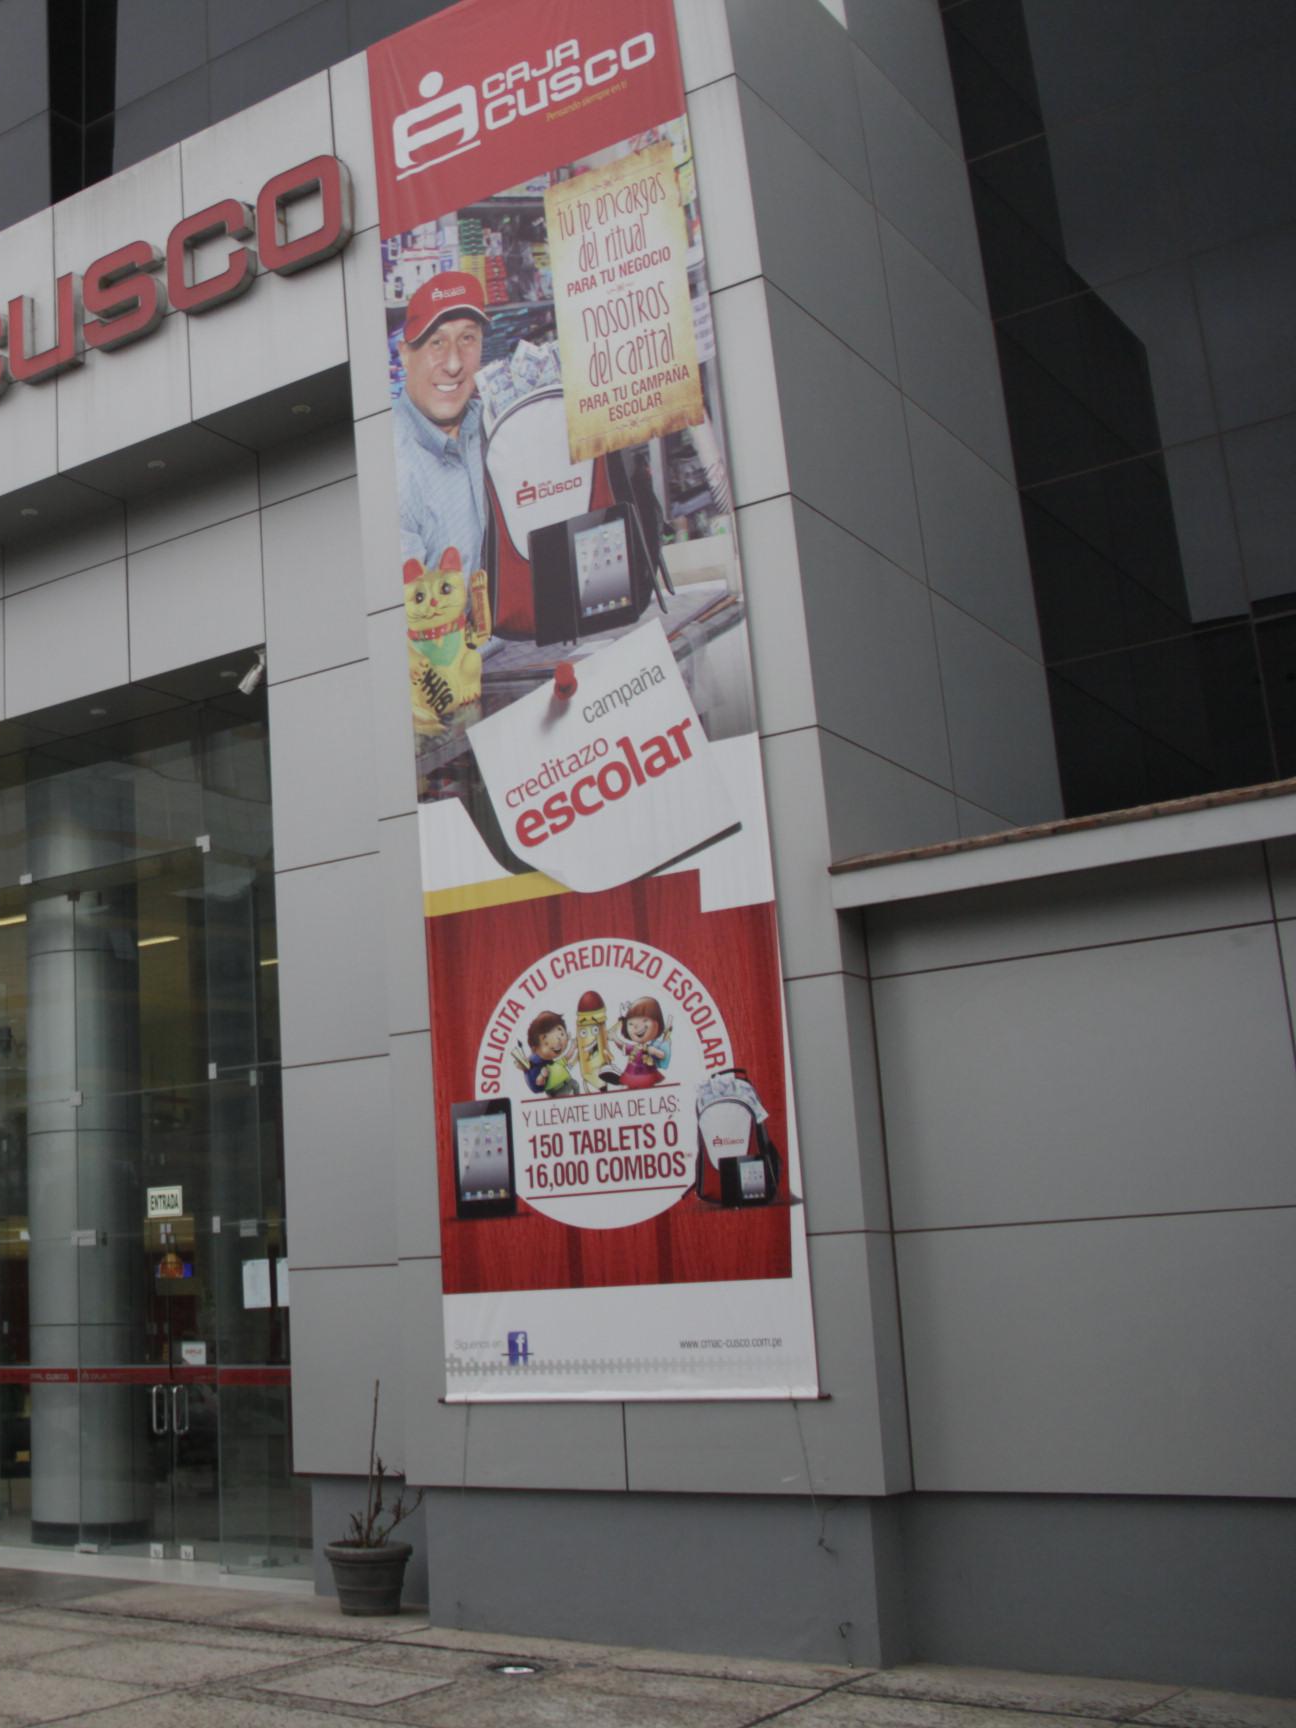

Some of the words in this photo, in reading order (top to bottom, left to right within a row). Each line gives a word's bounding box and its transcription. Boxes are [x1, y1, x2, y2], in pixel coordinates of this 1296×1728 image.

[482, 39, 579, 98] CAJA
[484, 32, 655, 130] CUSCO
[567, 275, 598, 297] PARA
[599, 267, 615, 285] TU
[619, 246, 671, 278] NEGOCIO
[579, 392, 610, 414] PARA
[612, 385, 628, 402] TU
[631, 363, 690, 397] CAMPAÑA
[608, 391, 663, 421] ESCOLAR
[538, 476, 582, 499] CUSCO
[582, 660, 666, 723] campaña
[505, 737, 609, 808] creditazo
[514, 718, 692, 848] escolar
[481, 999, 525, 1094] SOLICITA
[519, 969, 548, 999] TU
[550, 944, 663, 980] CREDITAZO
[662, 968, 726, 1070] ESCOLAR
[522, 1111, 532, 1128] Y
[535, 1103, 590, 1127] LLÉVATE
[594, 1101, 623, 1122] UNA
[628, 1098, 645, 1117] DE
[649, 1095, 681, 1114] LAS:
[528, 1132, 563, 1159] 150
[569, 1122, 656, 1156] TABLETS
[525, 1160, 589, 1192] 16,000
[596, 1151, 687, 1184] COMBOS
[150, 1194, 179, 1211] ENTRADA
